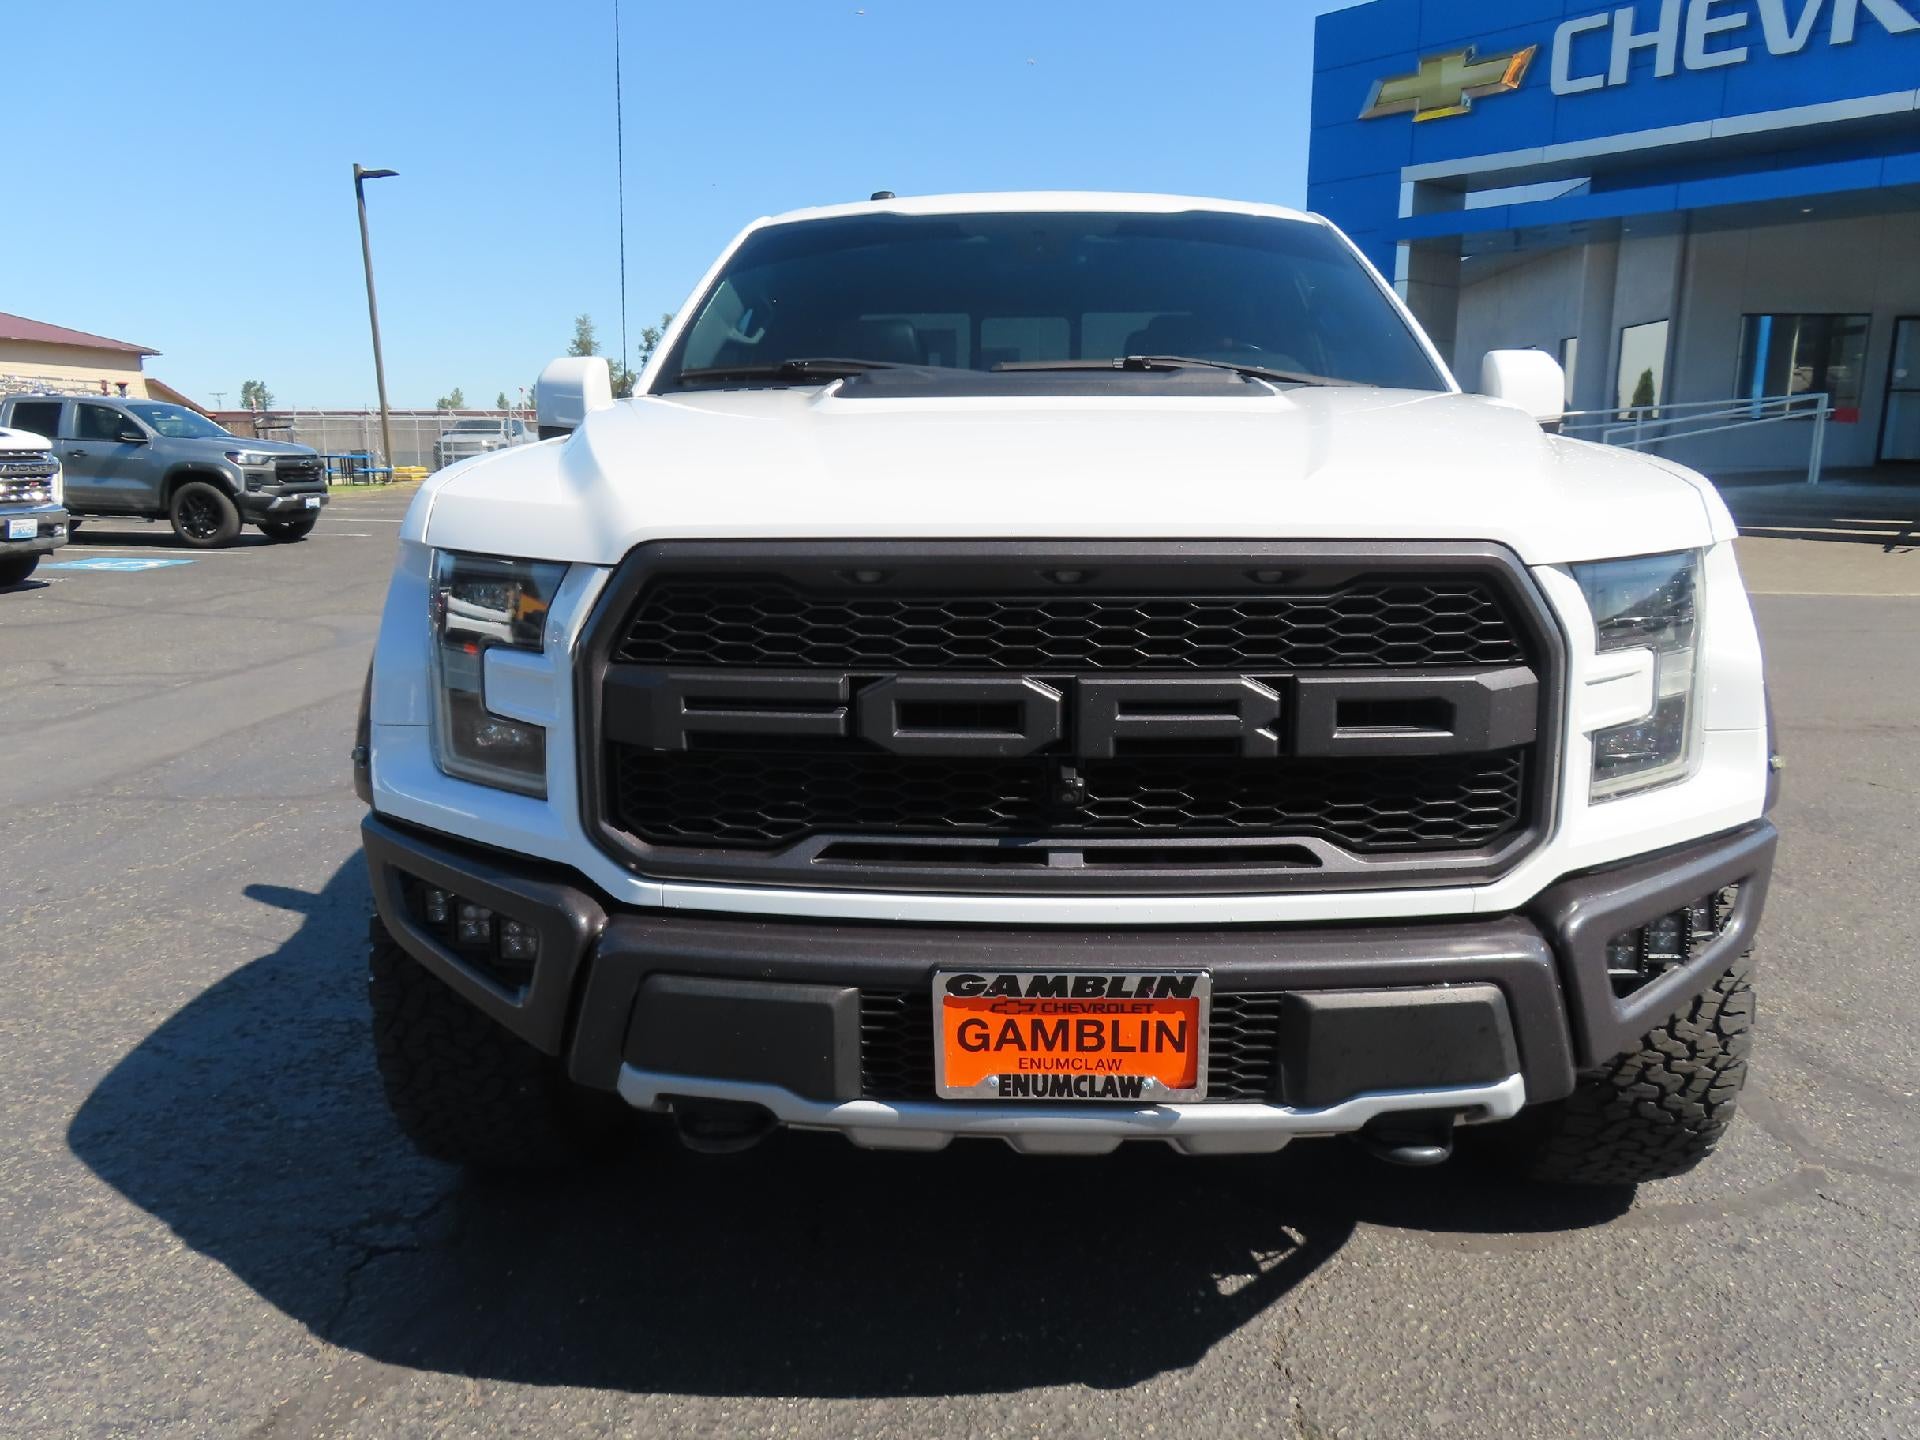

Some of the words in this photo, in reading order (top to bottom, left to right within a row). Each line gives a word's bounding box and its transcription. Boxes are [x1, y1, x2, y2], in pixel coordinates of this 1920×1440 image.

[602, 667, 1539, 760] FORD
[945, 974, 1198, 998] GAMBLIN
[1040, 1002, 1155, 1014] CHEVROLET
[957, 1017, 1188, 1053] GAMBLIN
[1018, 1057, 1122, 1071] ENUMCLAW
[998, 1074, 1145, 1098] ENUMCLAW
